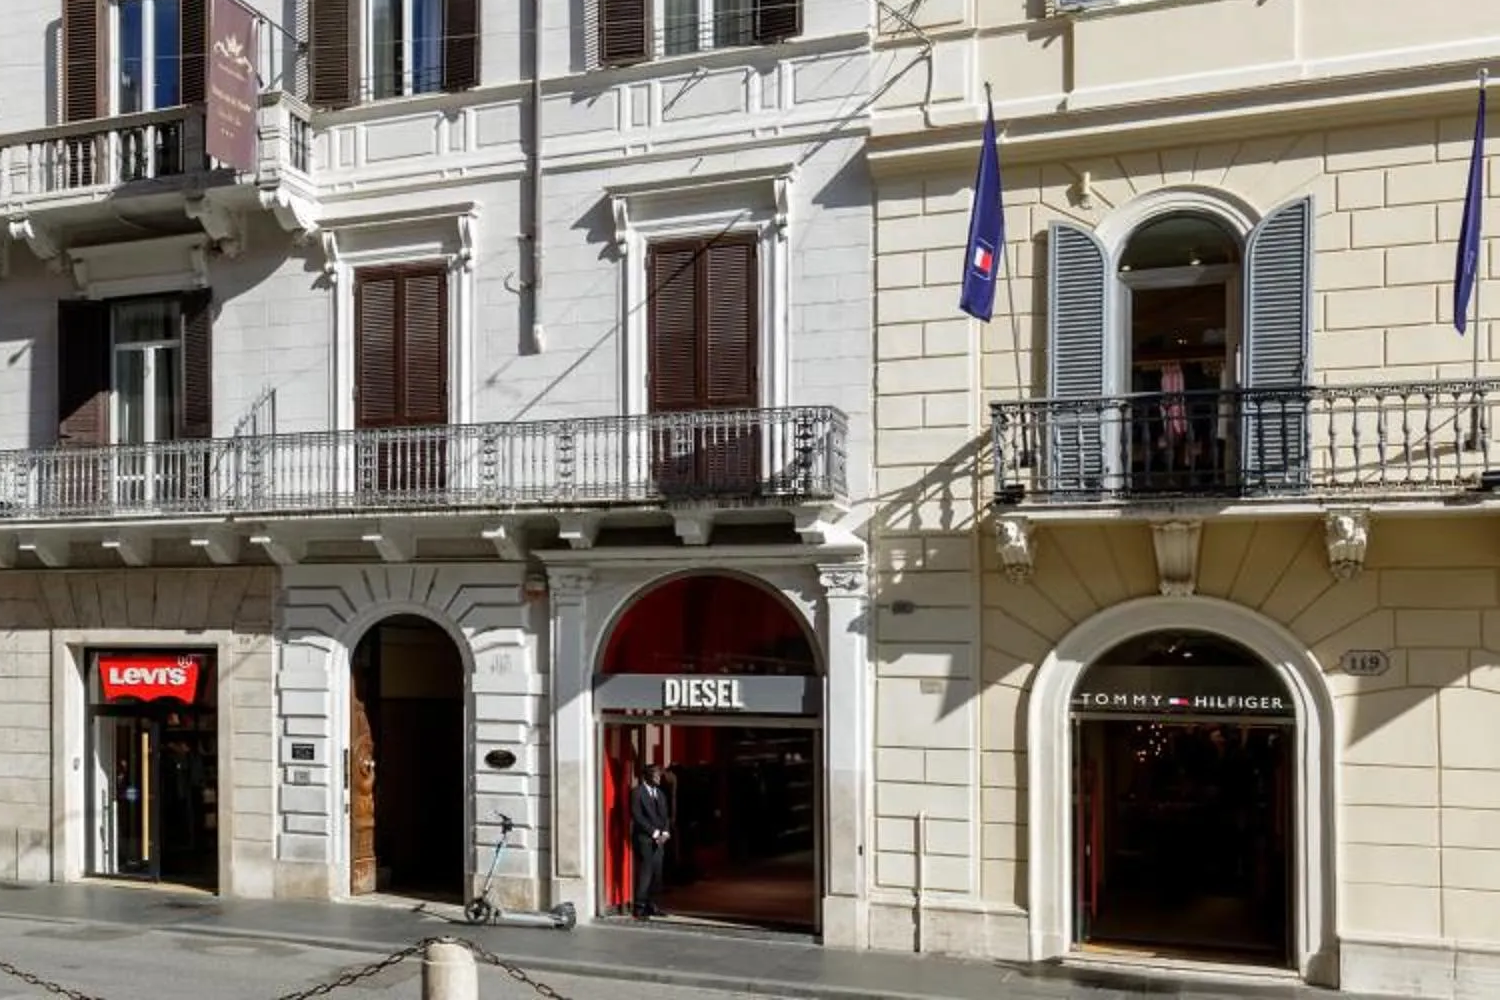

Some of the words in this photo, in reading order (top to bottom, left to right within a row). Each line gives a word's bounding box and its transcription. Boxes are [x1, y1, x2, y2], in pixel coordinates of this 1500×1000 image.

[664, 679, 745, 708] DIESEL
[1081, 693, 1162, 707] TOMMY
[1194, 695, 1284, 710] HILFIGER
